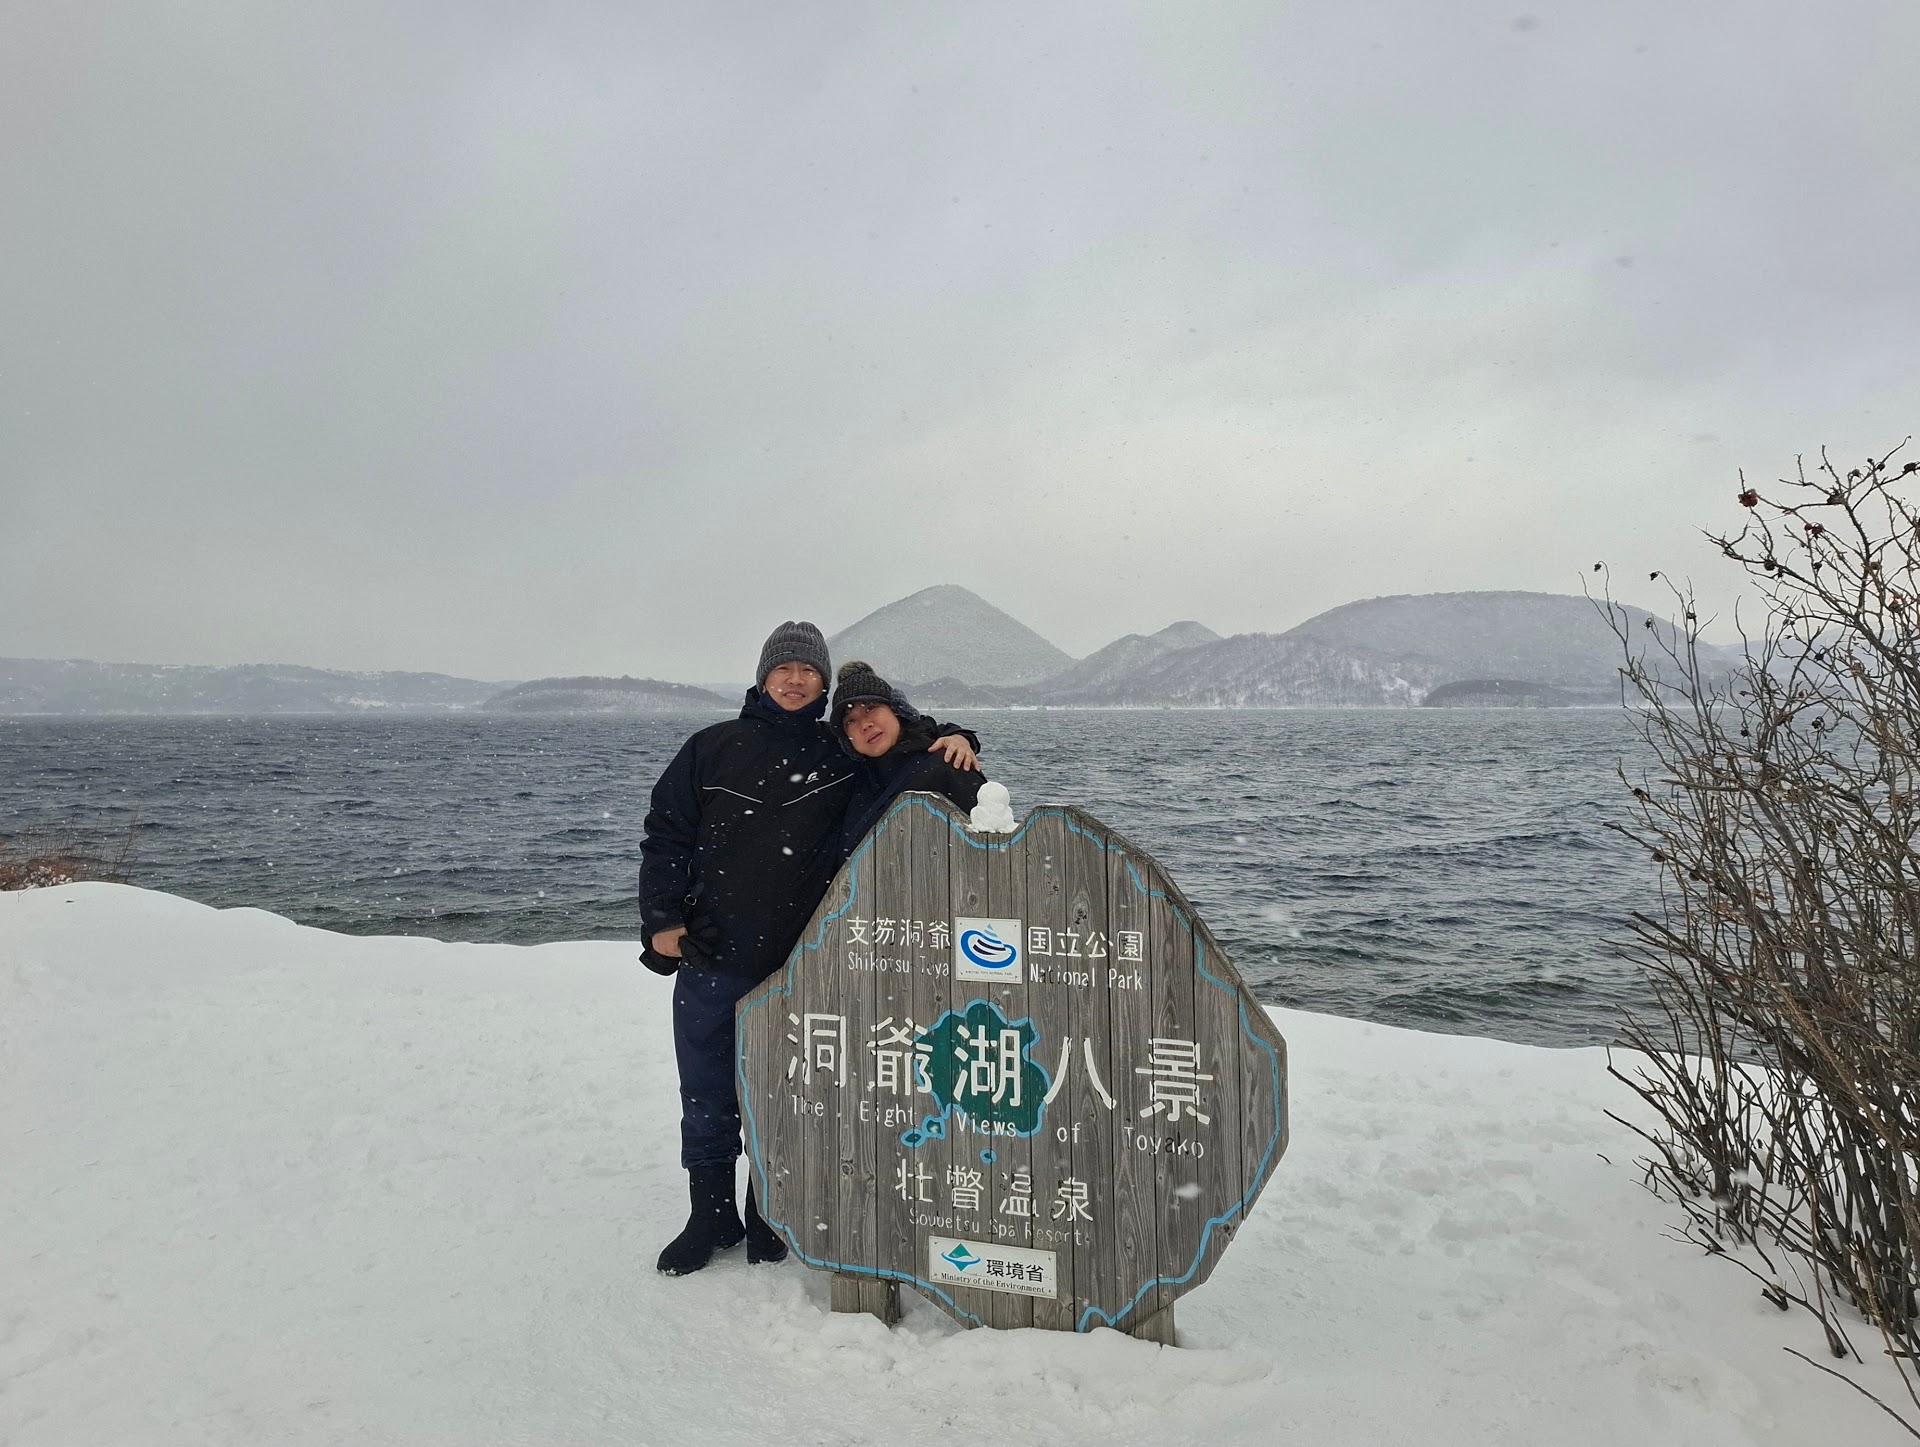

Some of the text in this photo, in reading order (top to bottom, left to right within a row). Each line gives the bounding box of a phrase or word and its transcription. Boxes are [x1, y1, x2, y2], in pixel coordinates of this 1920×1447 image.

[1028, 926, 1143, 962] 国立公園
[1030, 963, 1096, 987] National
[1108, 968, 1142, 990] Park
[785, 1012, 1214, 1125] 洞爺湖八景
[791, 1094, 1205, 1158] The Eight Views of Toyako
[895, 1158, 1094, 1222] 壮瞥温泉
[989, 1218, 1016, 1238] Spa
[1024, 1222, 1082, 1246] Resort
[941, 1272, 1046, 1293] Ministry of the Environment
[986, 1259, 1044, 1283] 環境省
